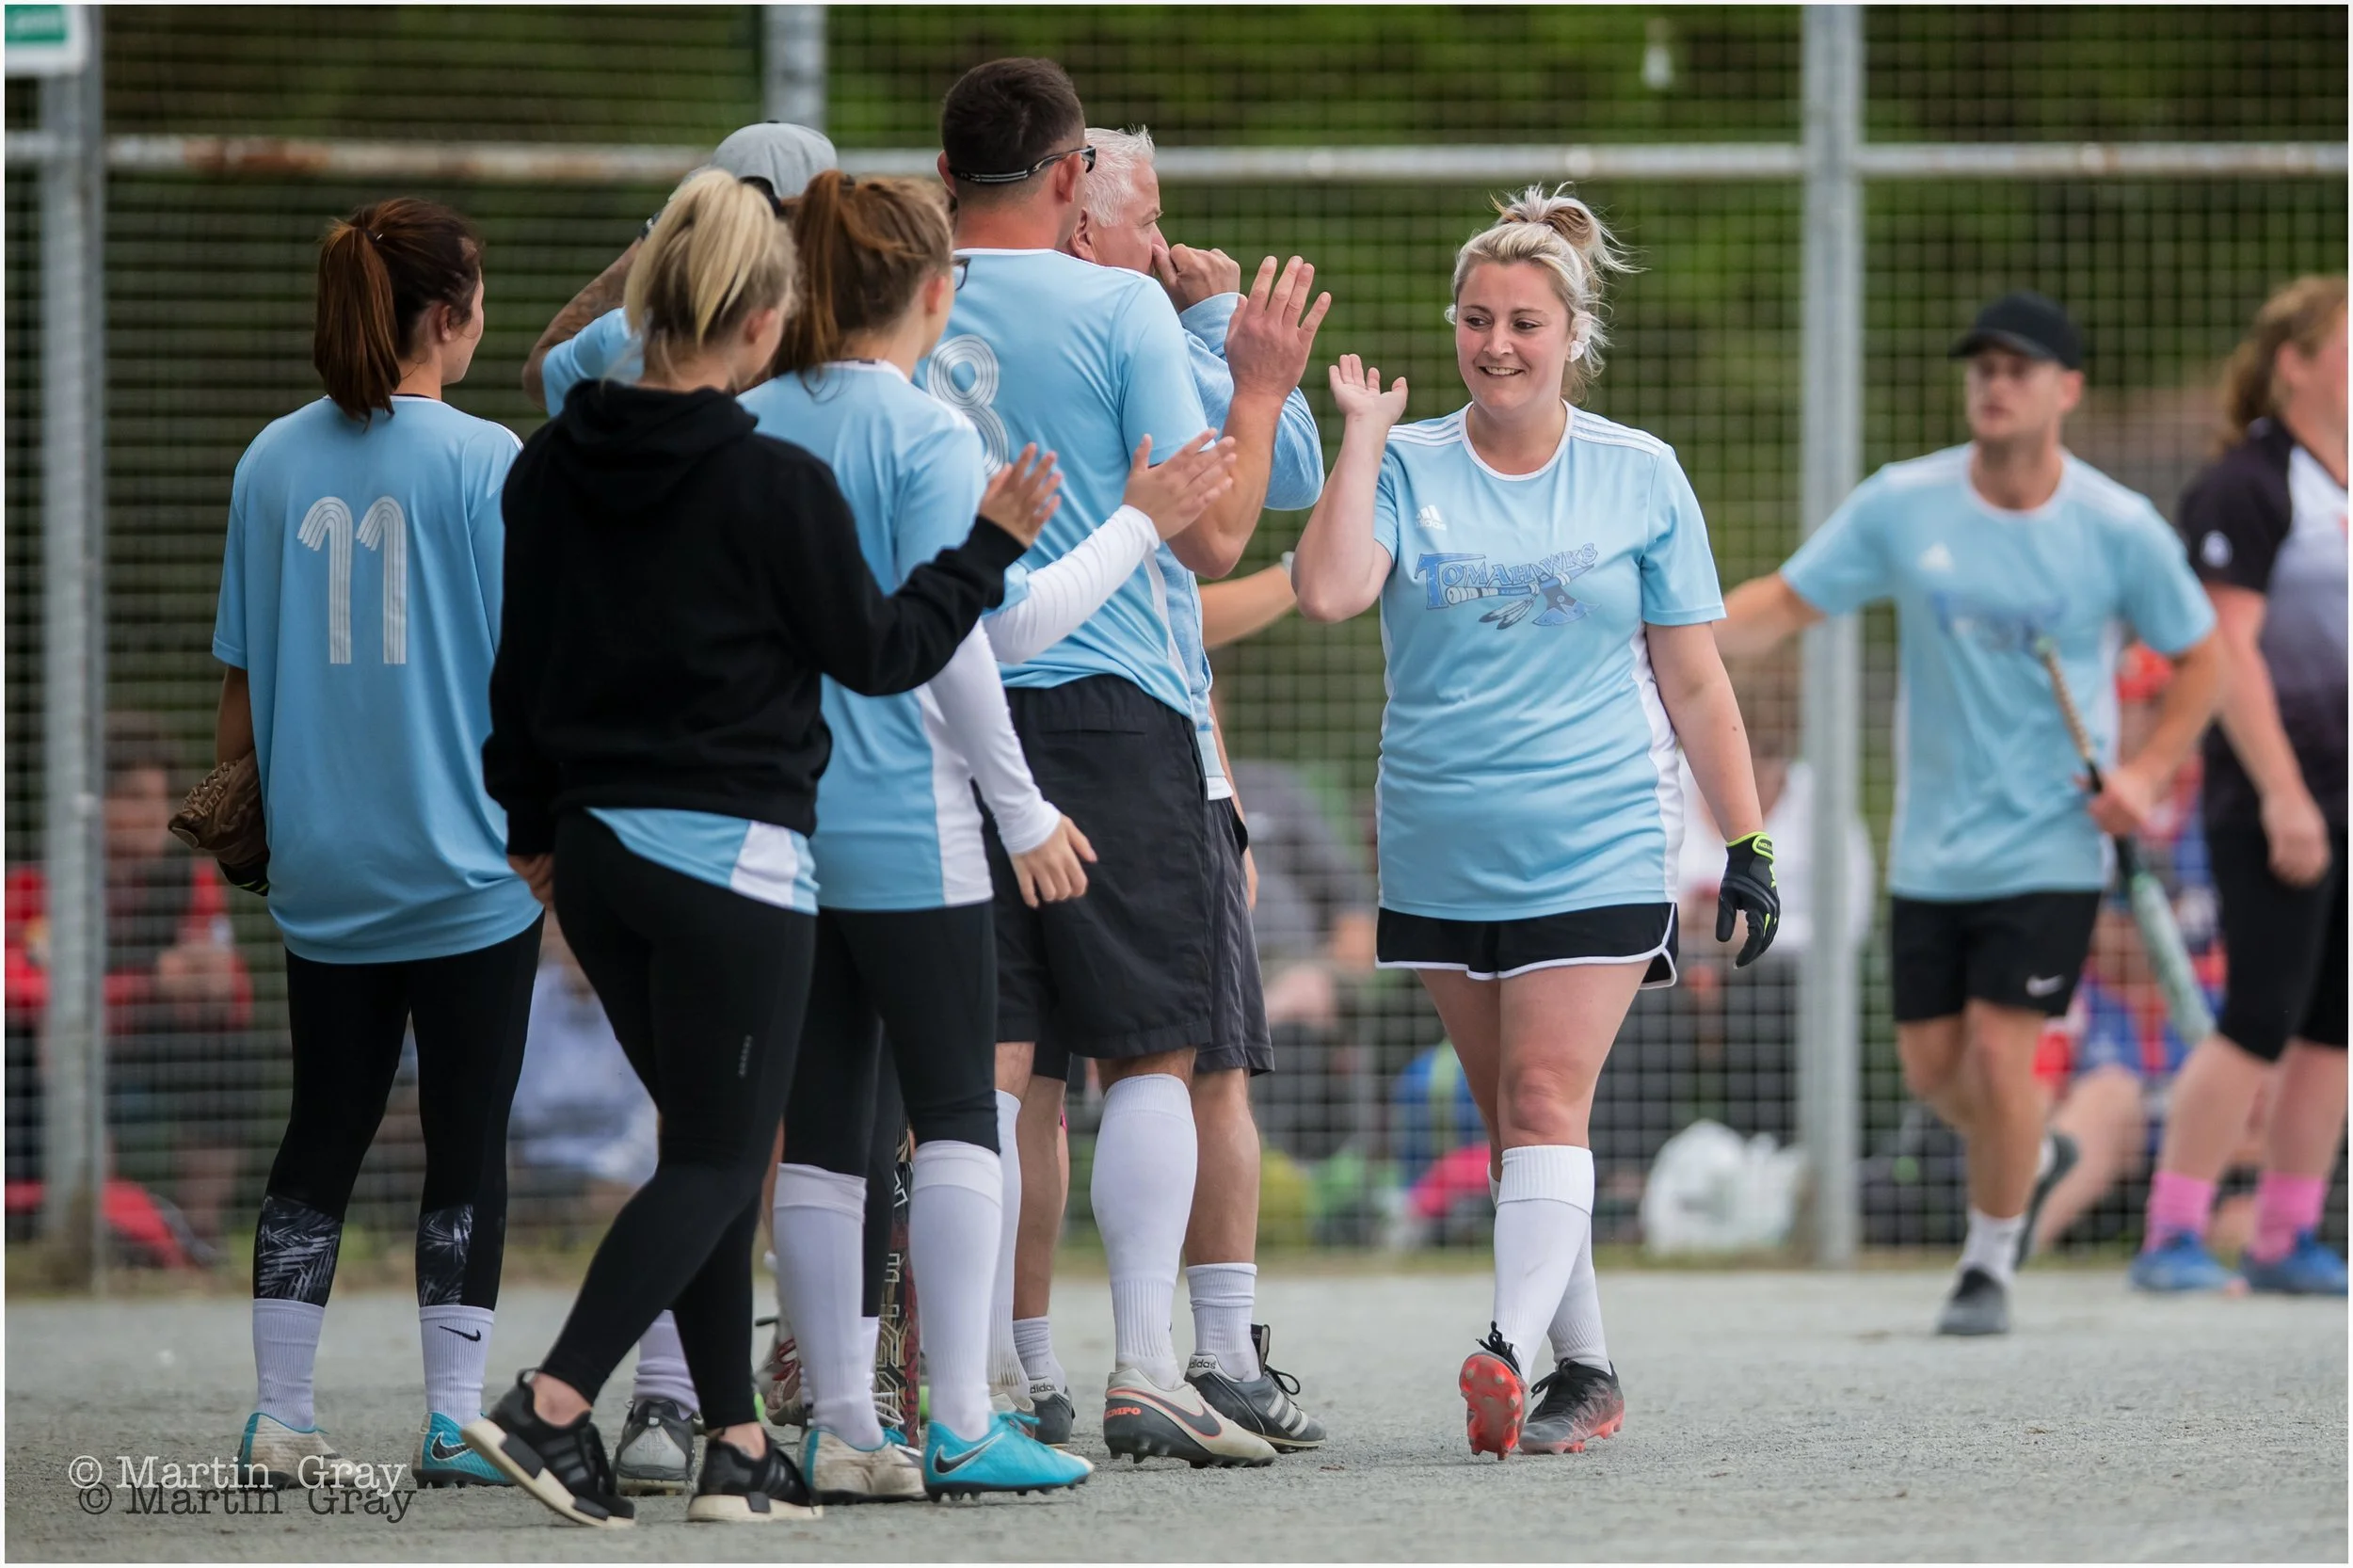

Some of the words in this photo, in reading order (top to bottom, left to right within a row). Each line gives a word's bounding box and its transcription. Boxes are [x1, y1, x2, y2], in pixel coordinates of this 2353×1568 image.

[927, 334, 1009, 478] 8
[296, 496, 407, 664] 11
[1415, 542, 1598, 610] TOMAHAWKS
[1189, 1358, 1217, 1369] didas
